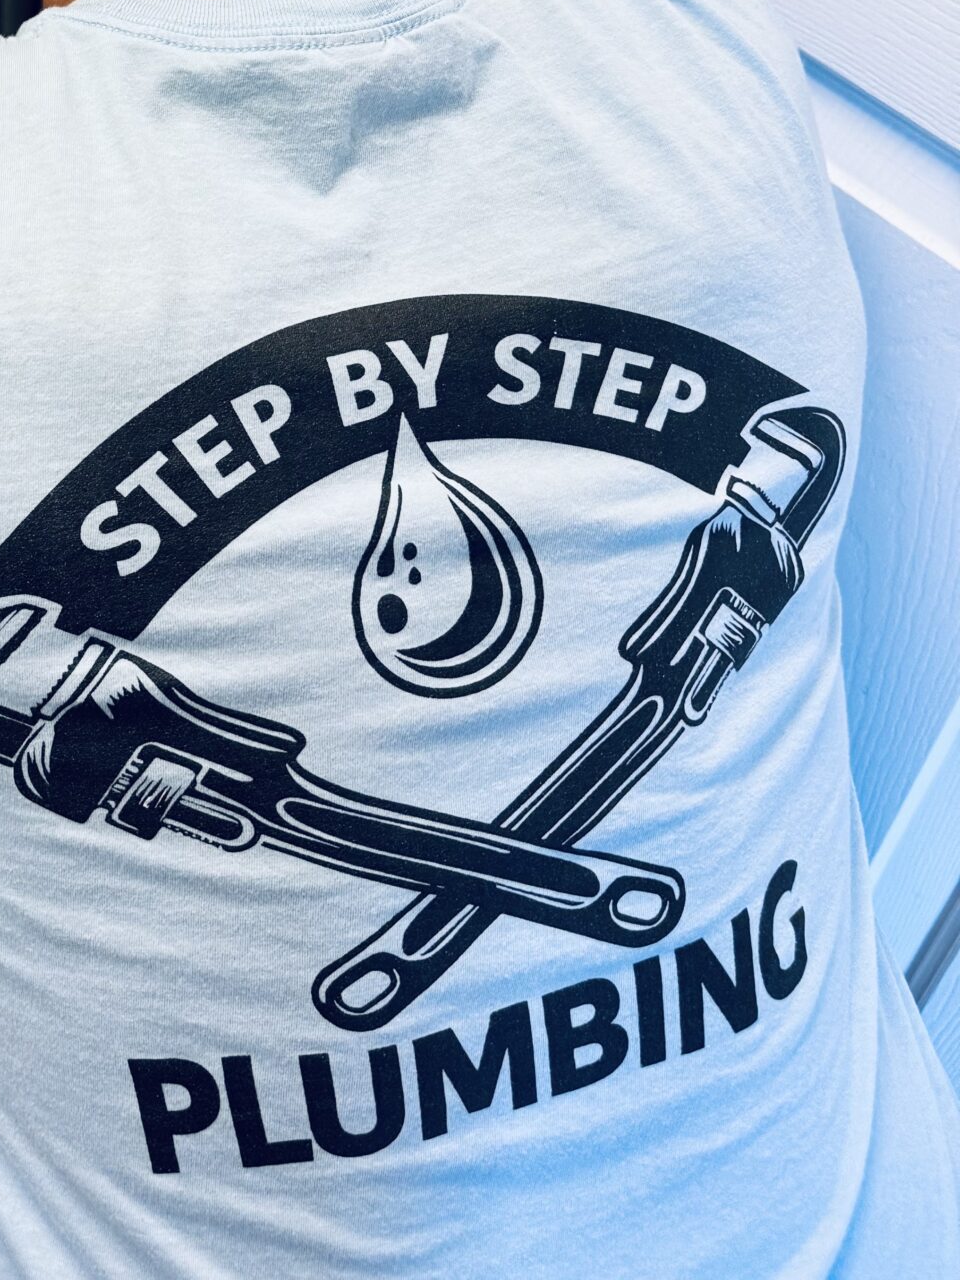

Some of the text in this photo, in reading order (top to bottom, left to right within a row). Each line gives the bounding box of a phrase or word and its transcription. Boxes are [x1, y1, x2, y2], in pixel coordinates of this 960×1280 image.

[80, 332, 707, 576] STEP BY STEP
[127, 858, 808, 1176] PLUMBING
